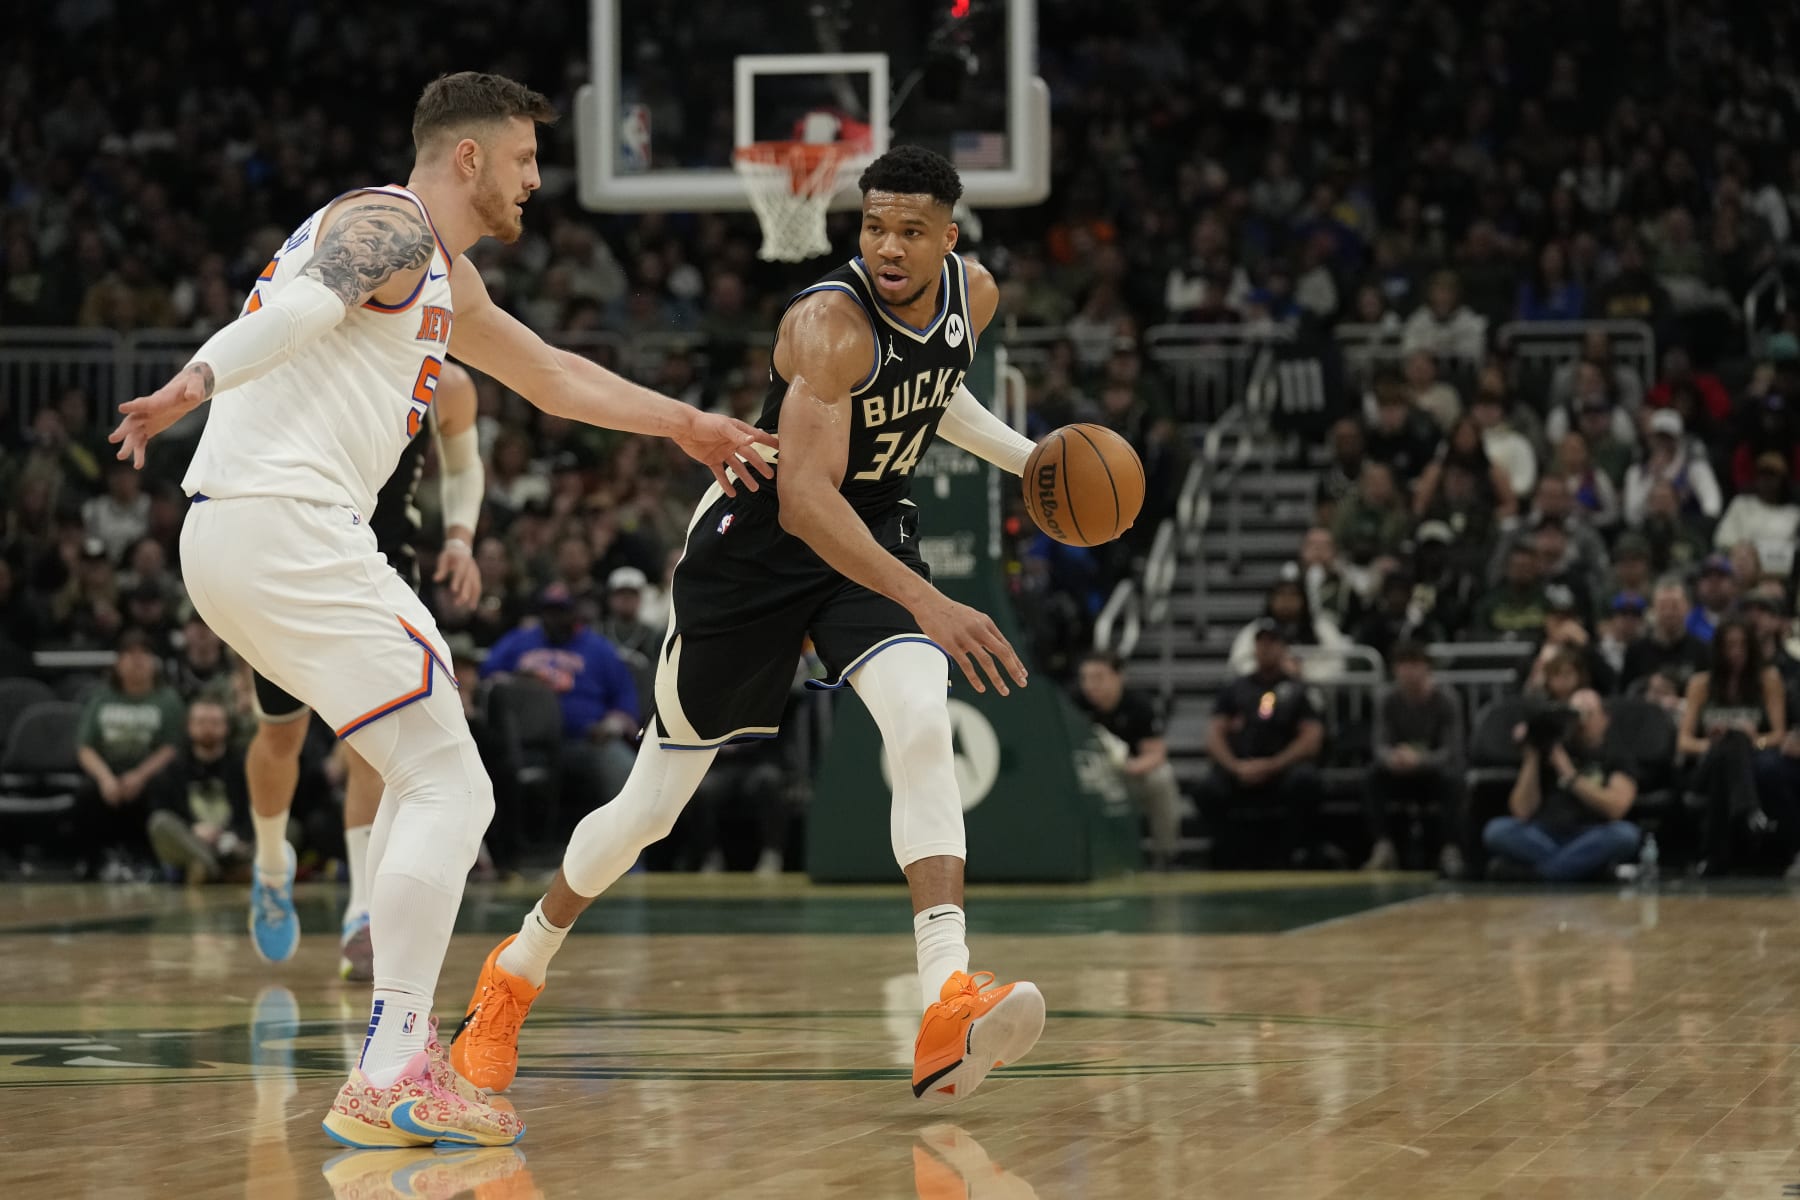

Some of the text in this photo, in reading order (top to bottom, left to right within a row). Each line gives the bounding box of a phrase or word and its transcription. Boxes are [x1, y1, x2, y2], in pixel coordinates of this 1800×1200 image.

[863, 367, 966, 428] BUCKS
[854, 423, 931, 480] 34
[1038, 463, 1068, 539] Wilson
